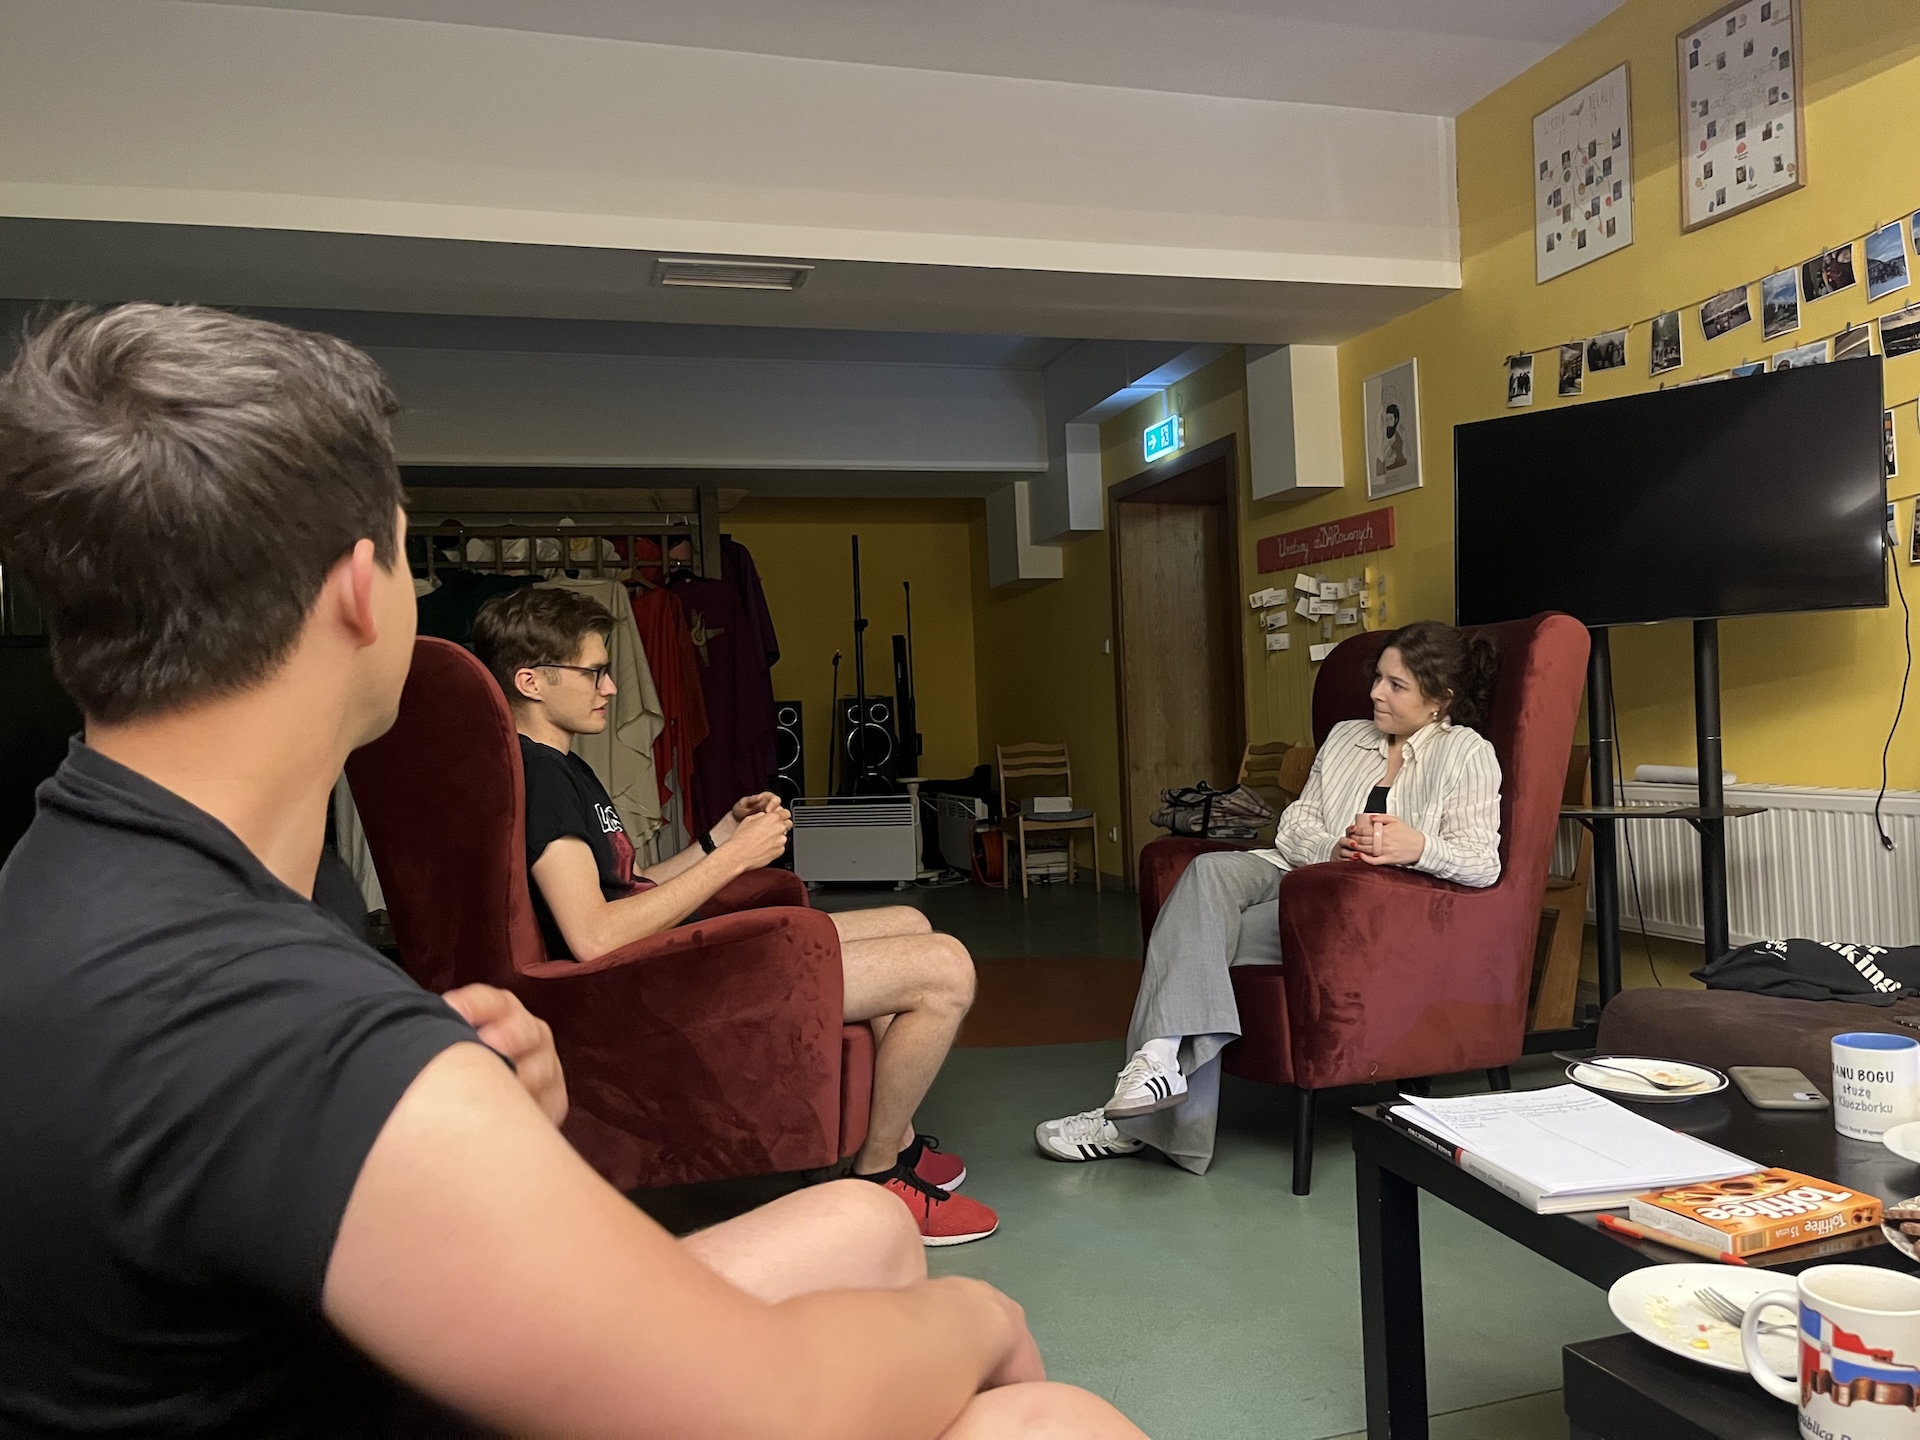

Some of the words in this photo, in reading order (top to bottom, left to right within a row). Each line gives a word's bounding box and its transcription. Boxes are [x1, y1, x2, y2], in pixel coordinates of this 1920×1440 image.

[1858, 1069, 1894, 1083] BOGU
[1696, 1186, 1853, 1220] Toffifee
[1790, 1225, 1800, 1238] 15
[1804, 1212, 1847, 1235] Toffifee
